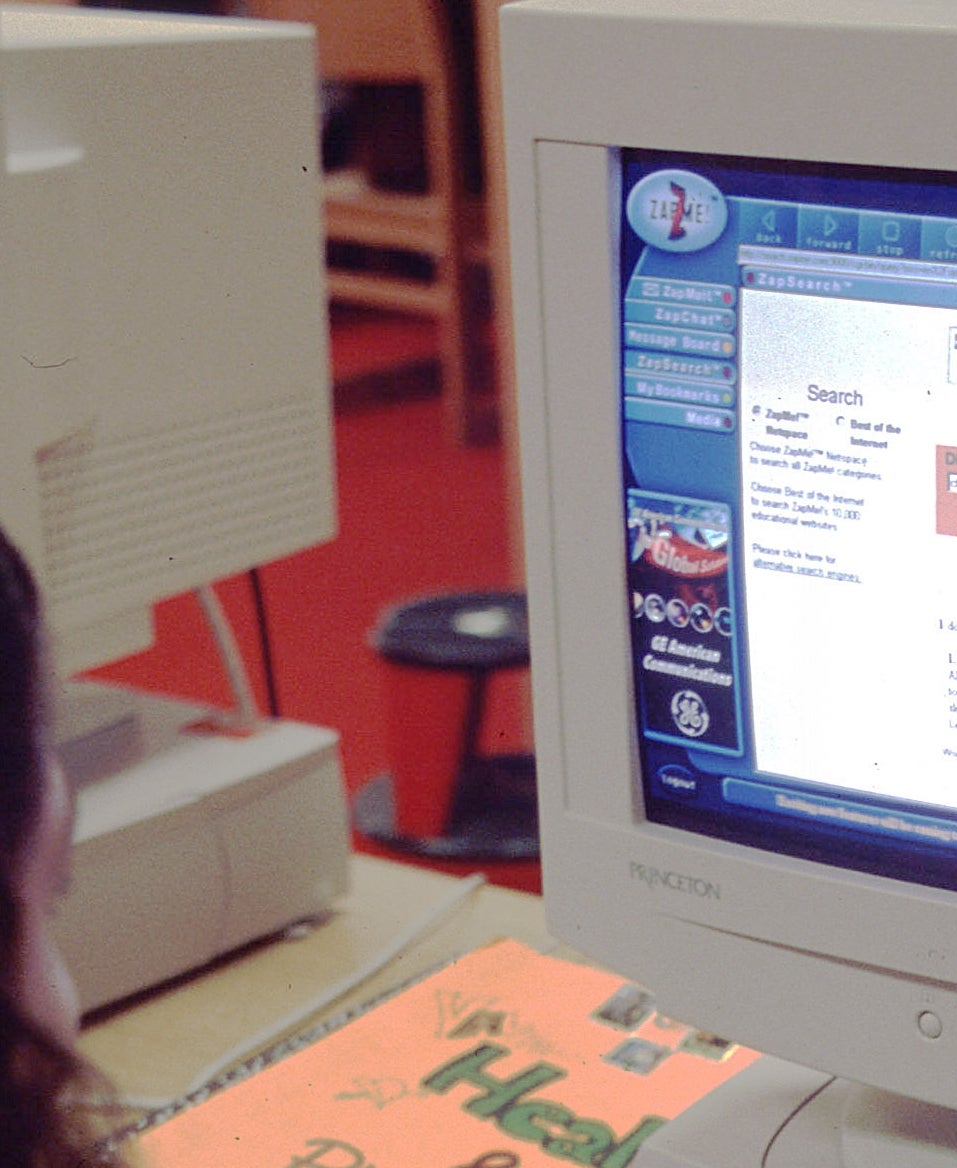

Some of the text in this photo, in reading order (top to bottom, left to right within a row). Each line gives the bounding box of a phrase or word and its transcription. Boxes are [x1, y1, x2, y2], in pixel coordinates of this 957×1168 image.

[806, 237, 852, 250] forward
[876, 244, 904, 256] stop
[628, 329, 720, 351] Message Board
[637, 381, 720, 403] MyBookmarks
[807, 384, 864, 407] Search
[686, 411, 721, 427] Media
[850, 419, 901, 434] Best of the
[850, 436, 888, 449] Internet
[749, 441, 868, 466] Choose Netspace
[750, 456, 801, 469] to search all
[750, 481, 864, 506] Choose Best of the Internet
[751, 496, 759, 506] to
[762, 499, 789, 510] search
[751, 511, 799, 526] educational
[752, 542, 836, 565] Please click here for
[797, 566, 824, 578] search
[651, 635, 721, 663] GE American
[629, 861, 721, 899] PRINCETON
